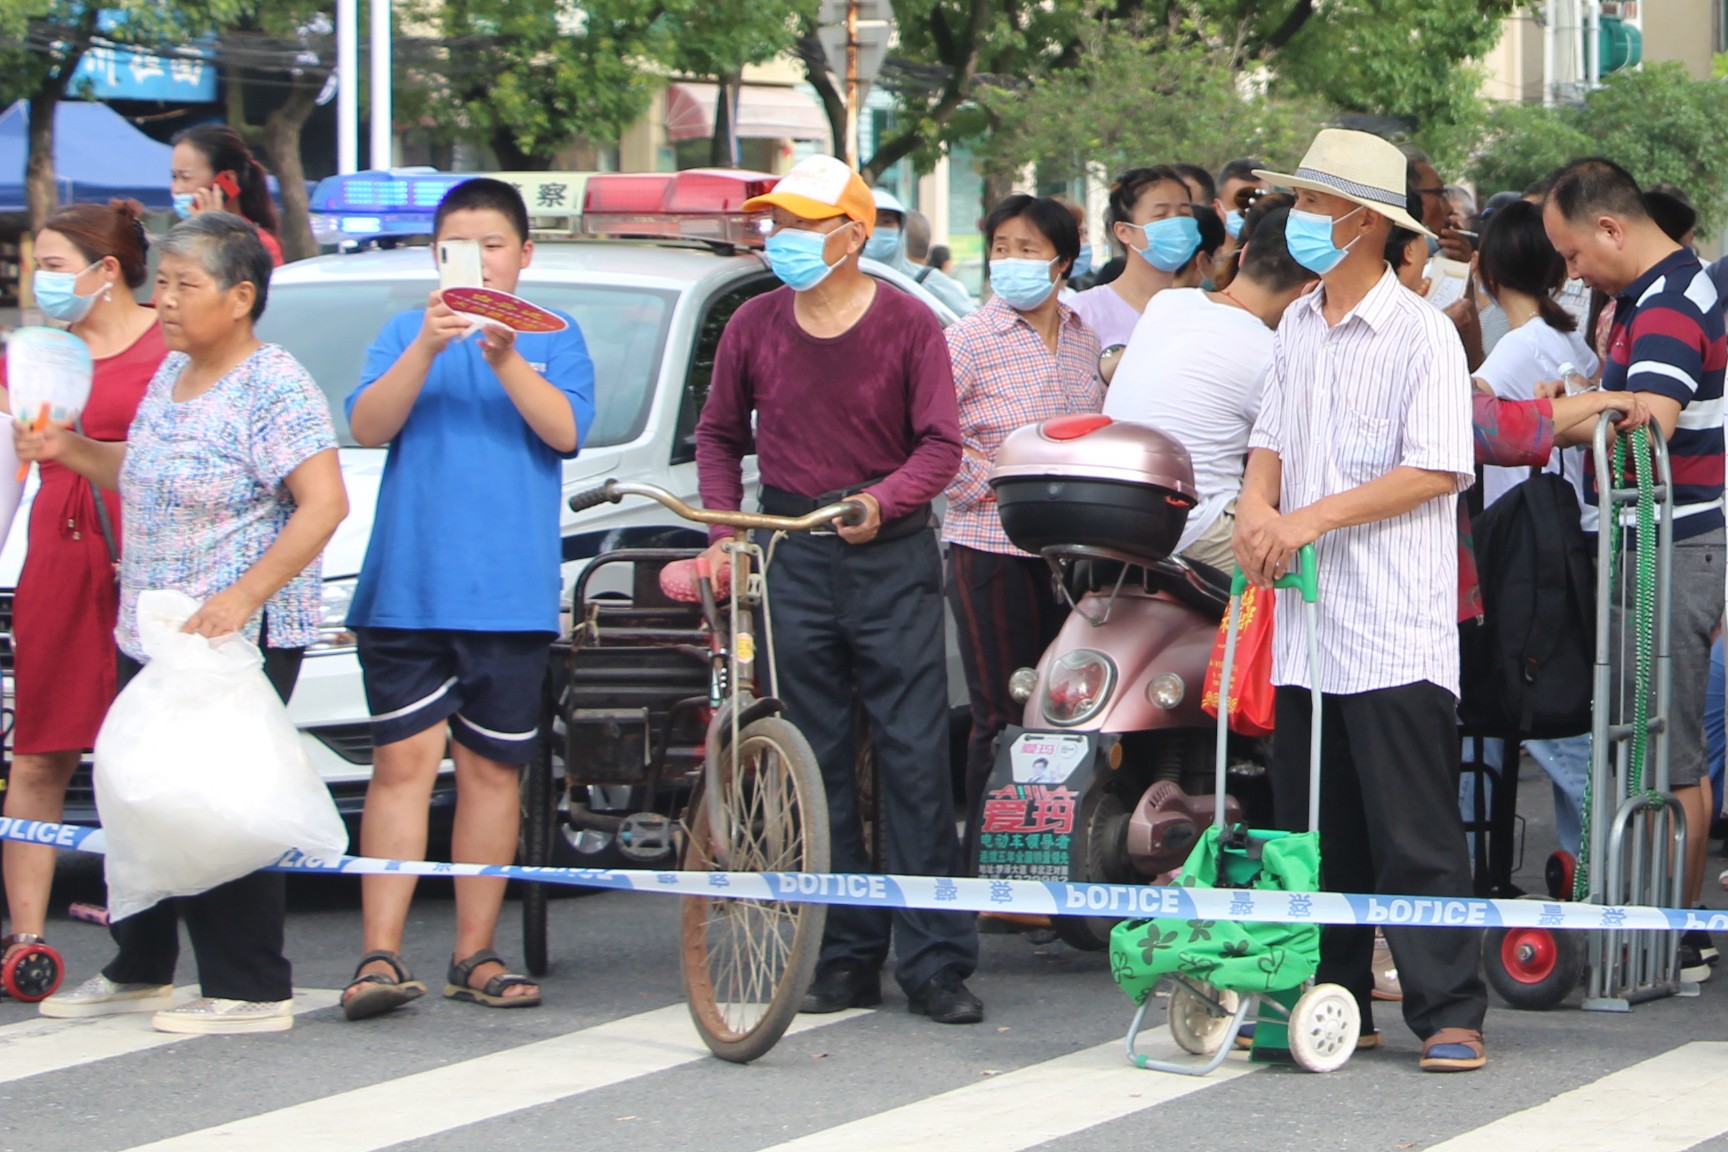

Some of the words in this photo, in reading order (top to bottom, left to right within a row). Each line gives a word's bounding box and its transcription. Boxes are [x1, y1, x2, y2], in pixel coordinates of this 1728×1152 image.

[981, 799, 1076, 833] 爱玛
[980, 833, 1070, 849] 电动车领导者
